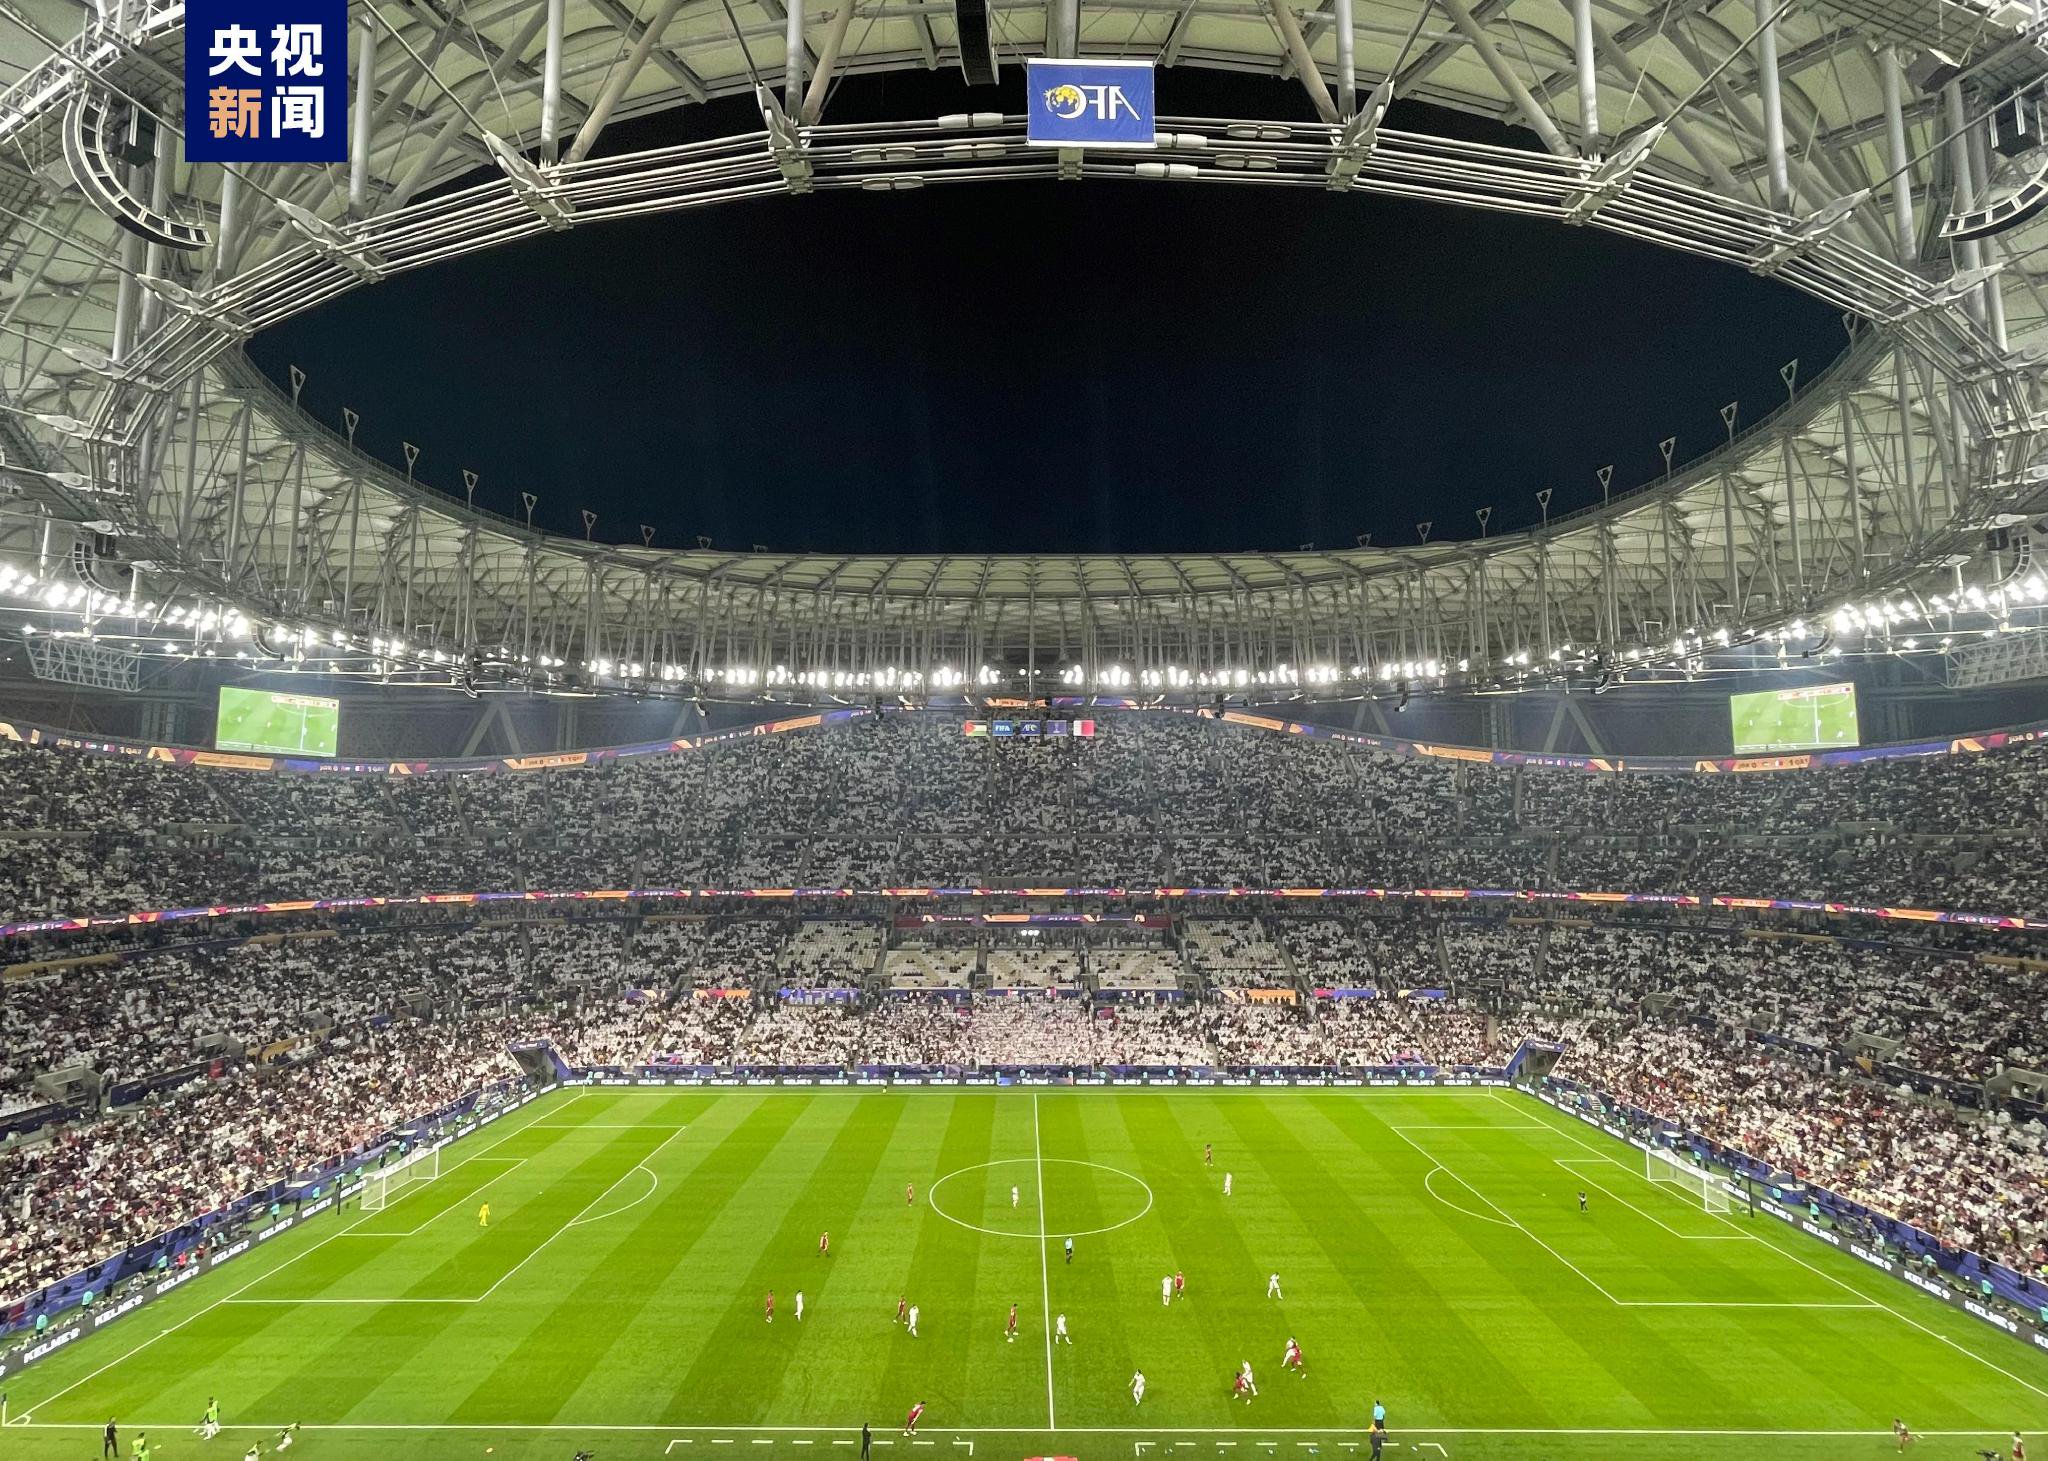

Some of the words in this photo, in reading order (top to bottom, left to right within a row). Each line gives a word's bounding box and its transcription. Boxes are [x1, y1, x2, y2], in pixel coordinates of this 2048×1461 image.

[995, 724, 1010, 732] FIFA
[1903, 1270, 1942, 1297] KELME
[1964, 1299, 2008, 1329] KELME
[24, 1331, 71, 1364] KELME
